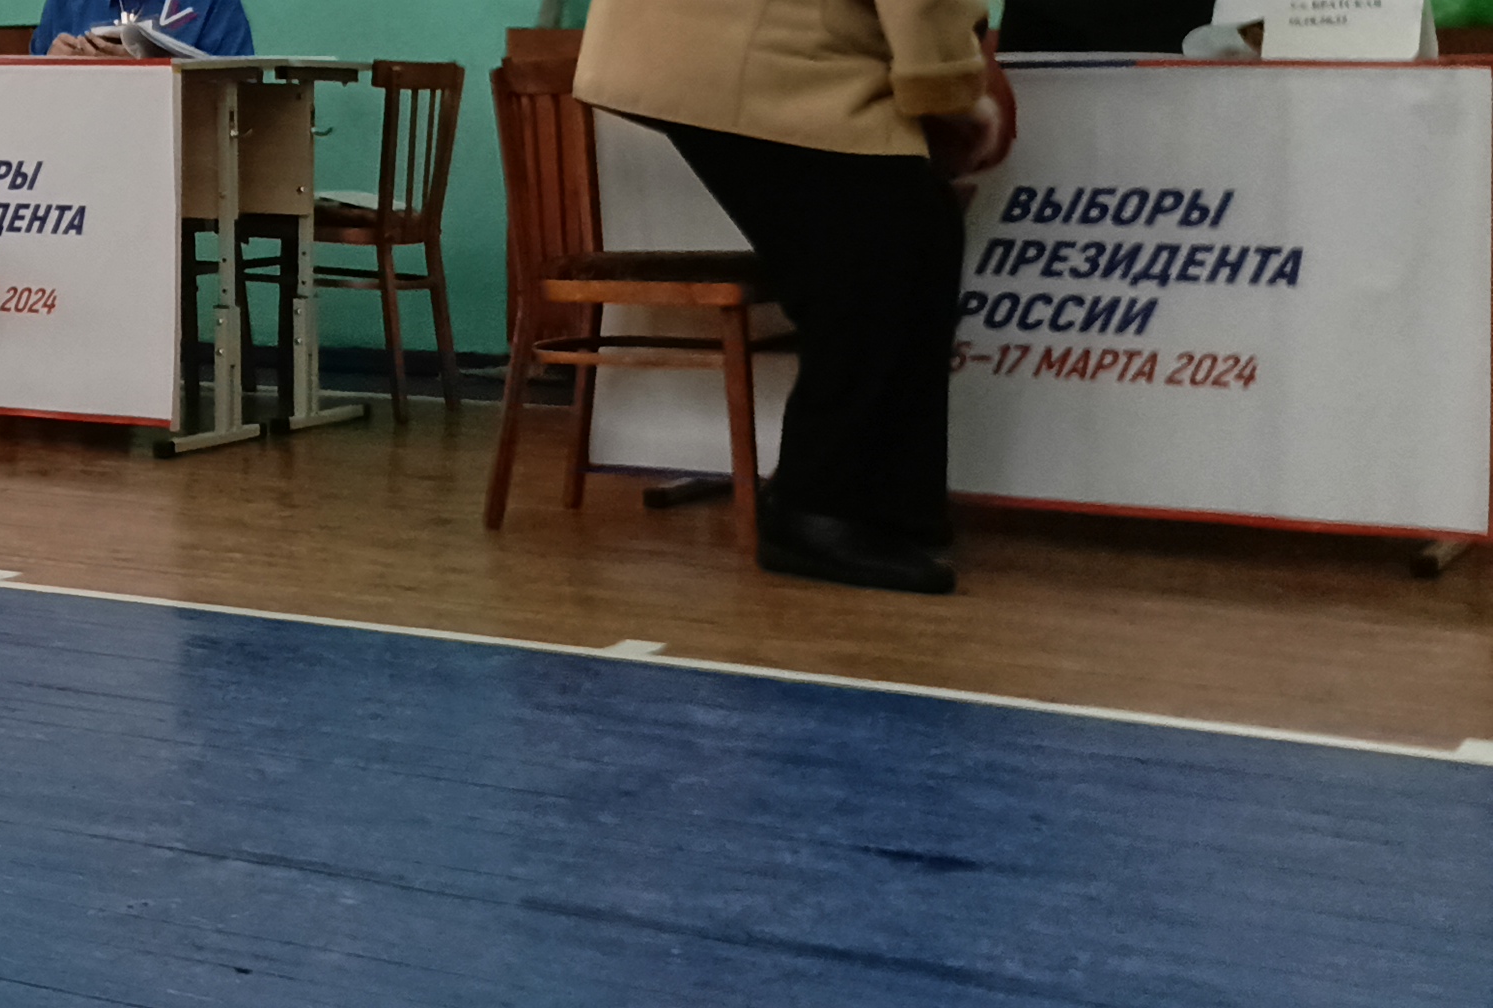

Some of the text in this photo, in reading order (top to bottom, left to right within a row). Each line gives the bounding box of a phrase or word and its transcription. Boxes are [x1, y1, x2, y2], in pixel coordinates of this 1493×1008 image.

[999, 185, 1235, 229] ВЫБОРЫ
[974, 237, 1304, 288] ПРЕЗИДЕНТА
[0, 286, 58, 315] 2024
[960, 291, 1160, 336] РОССИИ
[1033, 345, 1159, 384] МАРТА
[1164, 351, 1259, 391] 2024
